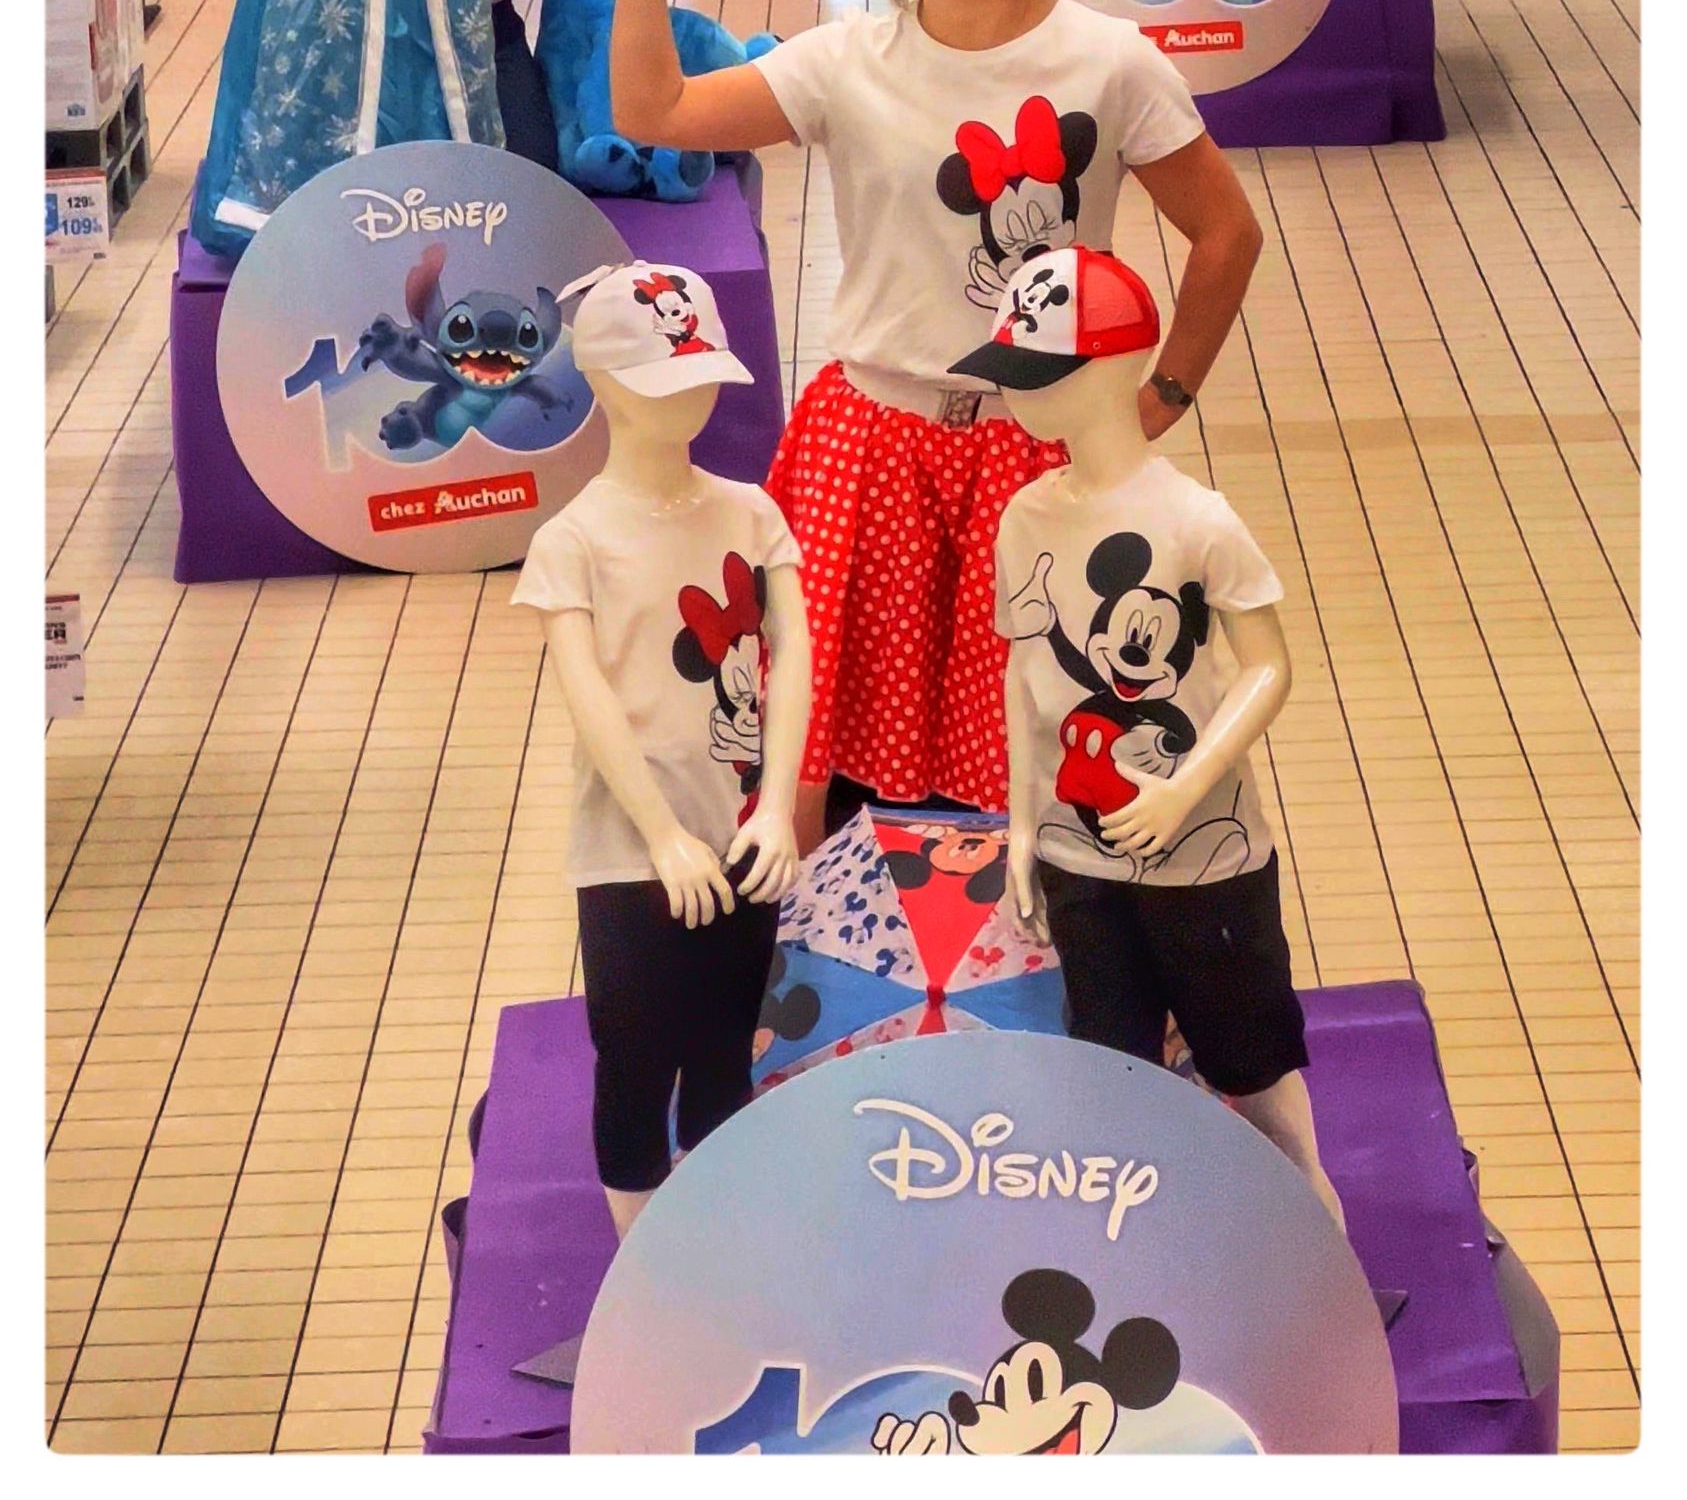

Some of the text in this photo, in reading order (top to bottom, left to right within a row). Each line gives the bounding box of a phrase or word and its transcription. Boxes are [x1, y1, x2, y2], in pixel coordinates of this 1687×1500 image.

[1164, 29, 1235, 47] Auchan
[381, 486, 526, 520] chez Auchan
